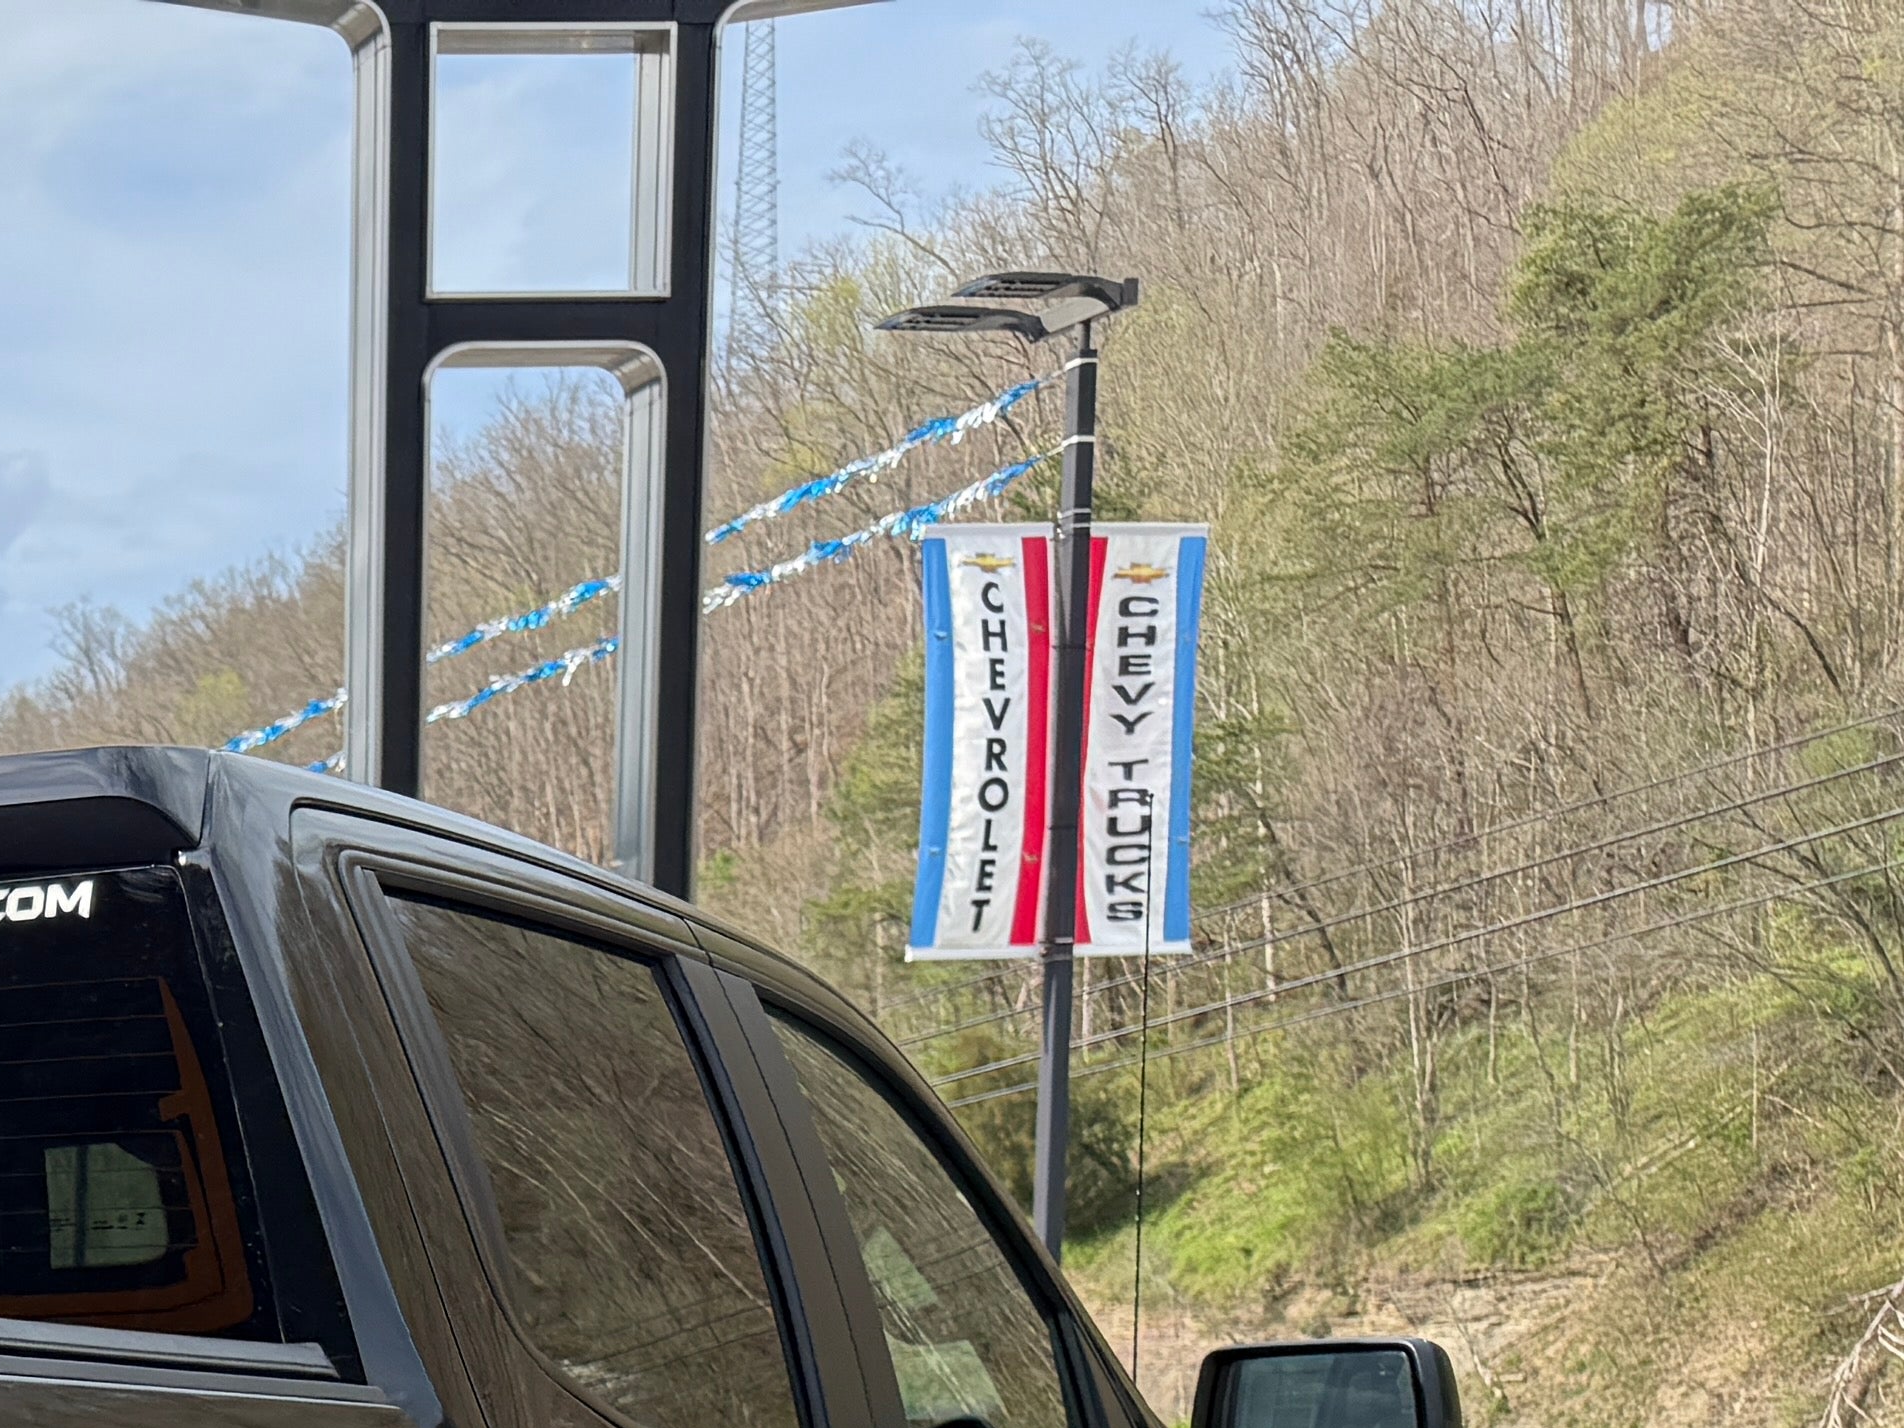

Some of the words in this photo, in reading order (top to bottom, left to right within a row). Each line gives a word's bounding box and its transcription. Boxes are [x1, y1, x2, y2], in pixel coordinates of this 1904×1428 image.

[1111, 595, 1160, 735] CHEVY
[971, 581, 1012, 933] CHEVROLET
[1105, 758, 1151, 922] TRUCKS
